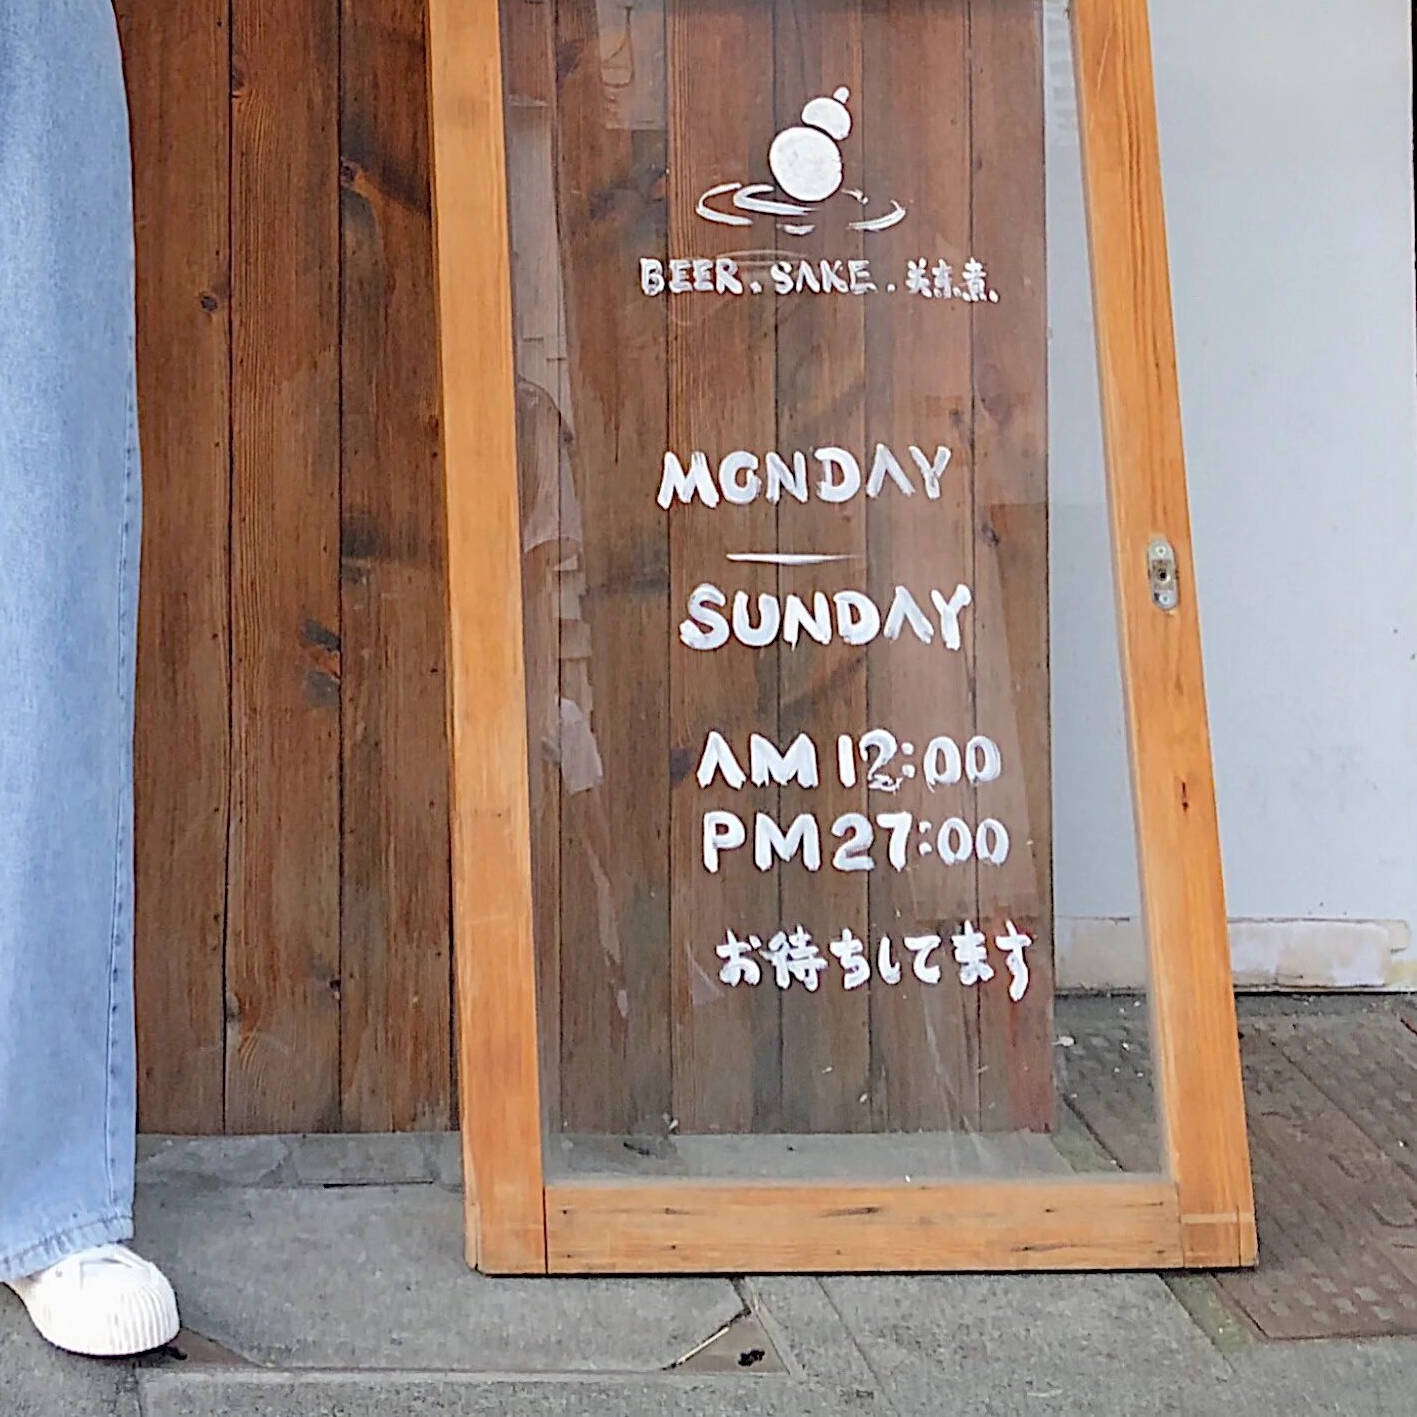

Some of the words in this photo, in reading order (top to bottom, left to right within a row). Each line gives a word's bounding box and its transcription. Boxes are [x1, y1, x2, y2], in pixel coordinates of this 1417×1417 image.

[657, 443, 952, 510] MONDAY
[679, 582, 972, 651] SUNDAY
[715, 919, 1033, 1003] お待ちしてます
